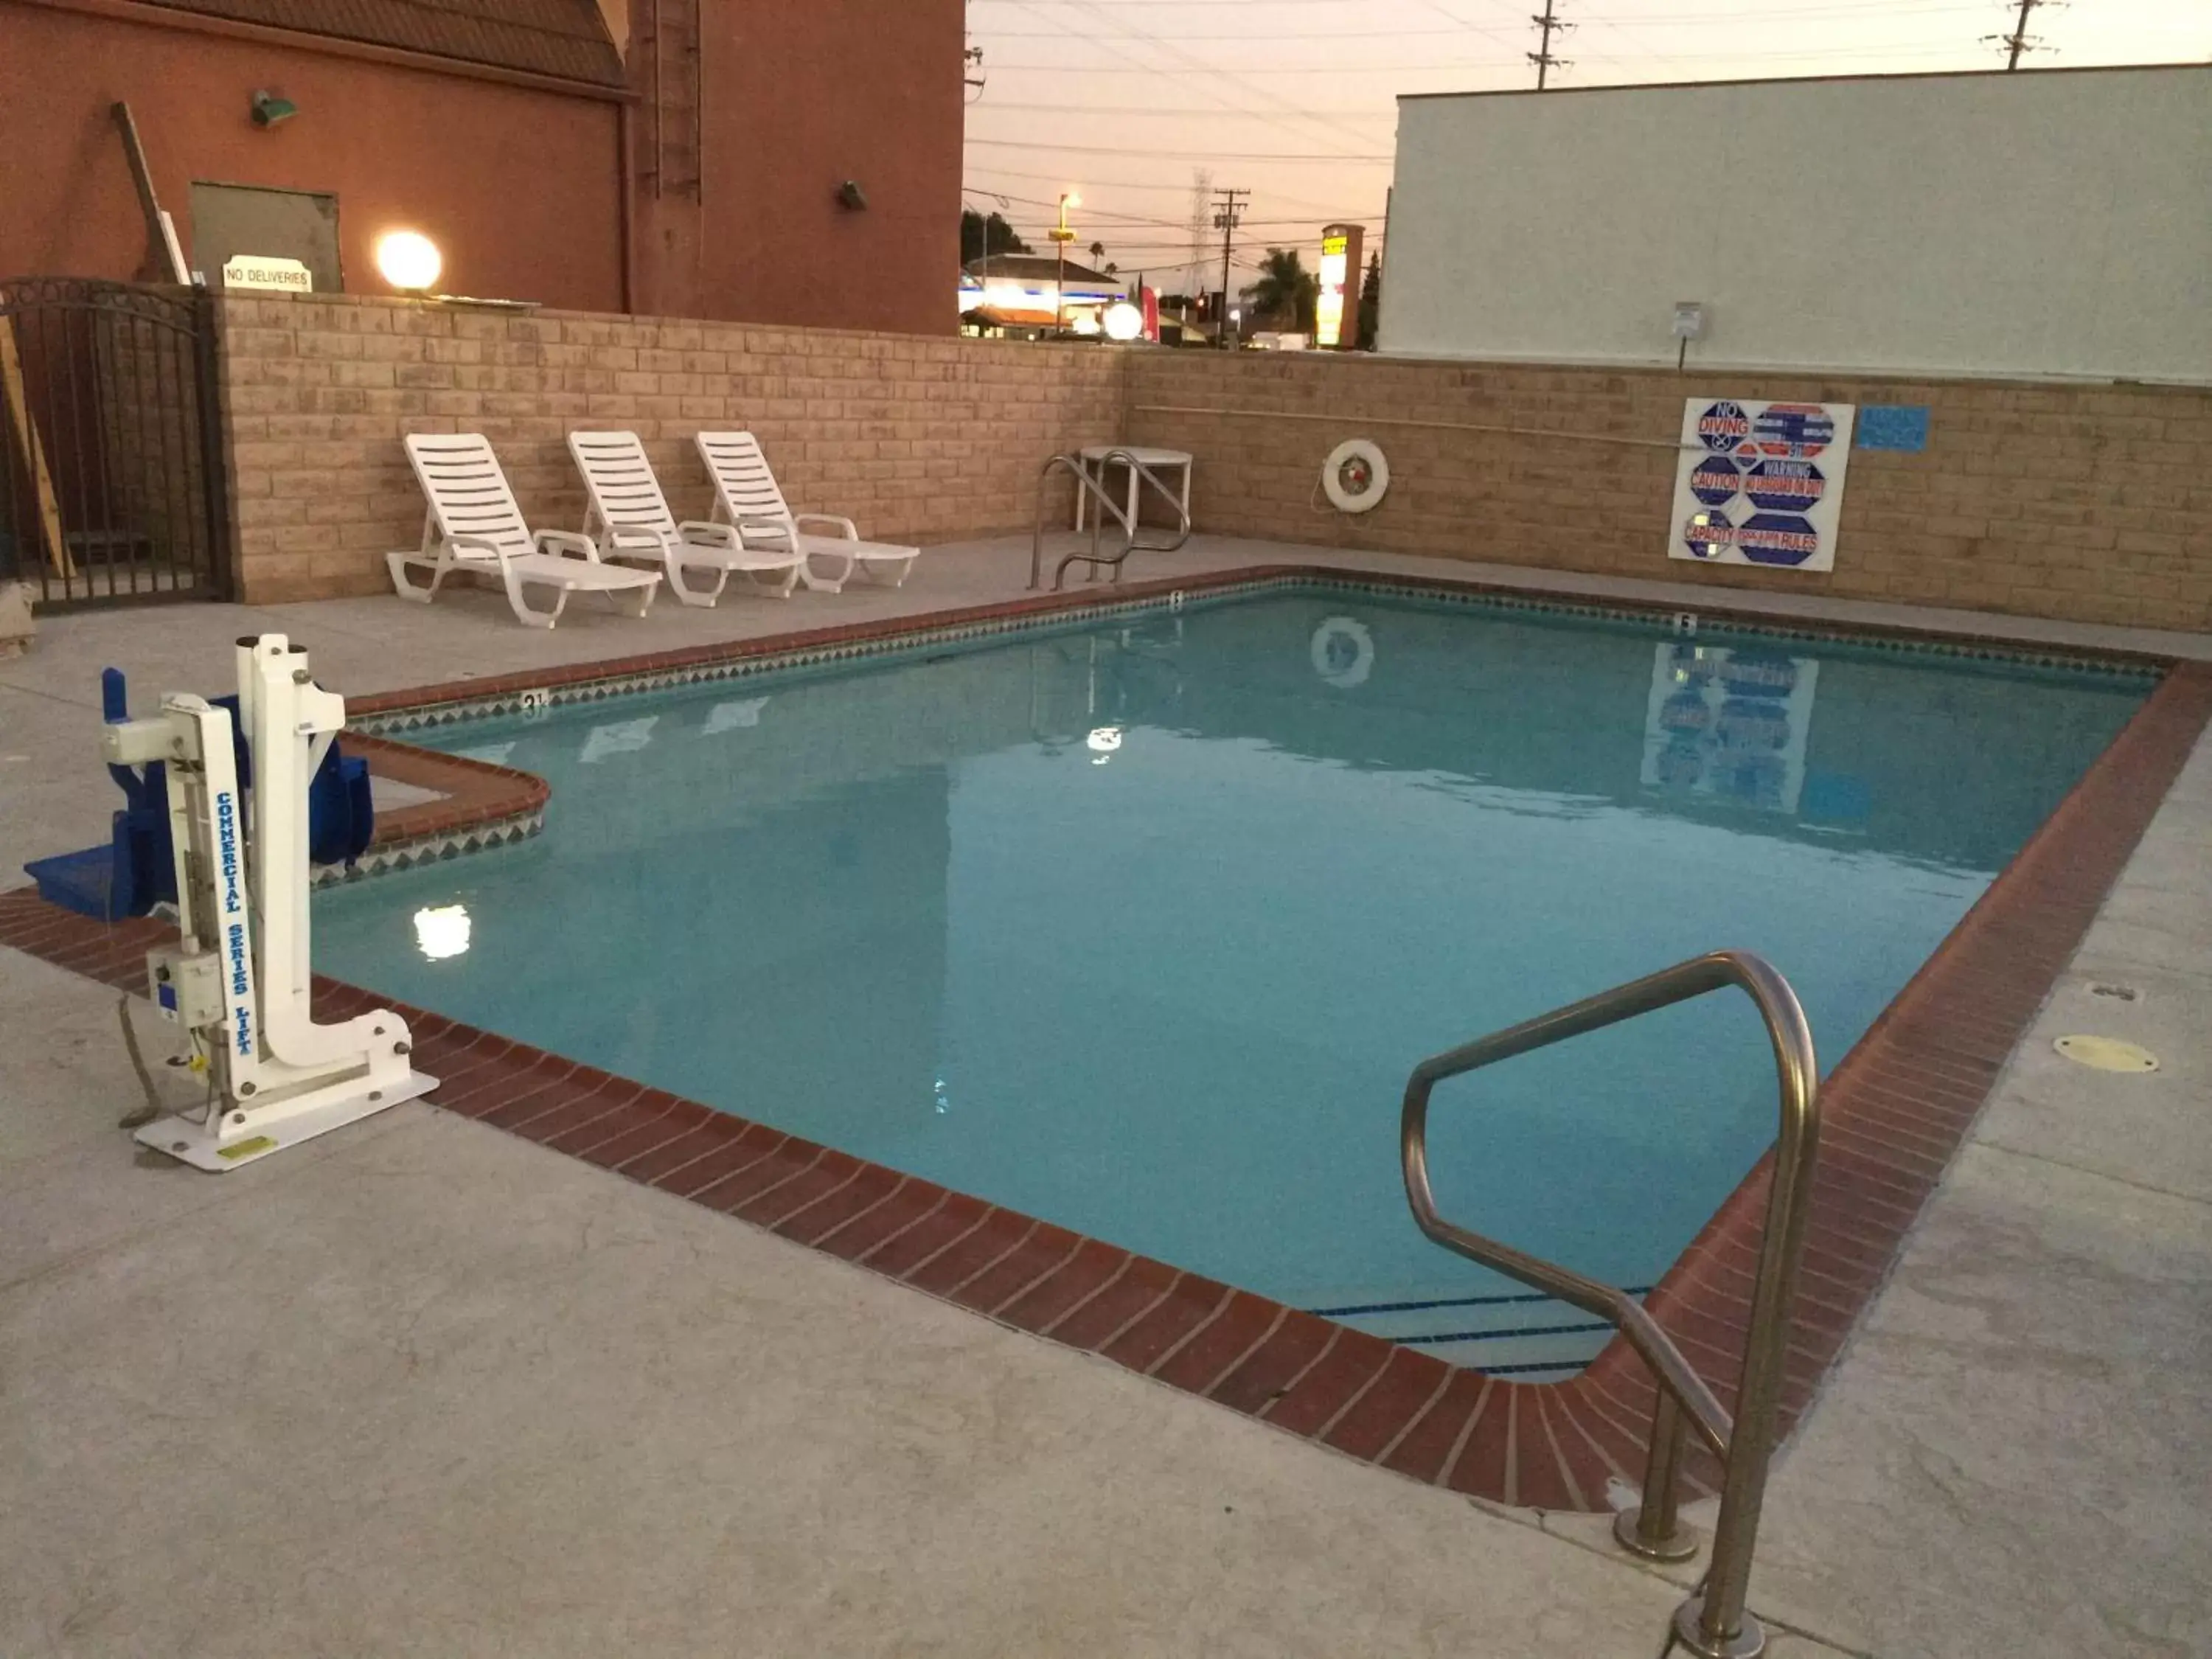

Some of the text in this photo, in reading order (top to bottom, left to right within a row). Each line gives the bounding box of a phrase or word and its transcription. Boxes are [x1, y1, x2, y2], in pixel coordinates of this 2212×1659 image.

[226, 268, 308, 285] NO DELIVERIES
[1716, 401, 1737, 418] NO
[1699, 415, 1748, 435] DIVING
[1764, 459, 1812, 479] WARNING
[1691, 470, 1739, 492] CAUTION
[1685, 523, 1733, 544] CAPACITY
[1781, 532, 1817, 552] RULES
[217, 792, 251, 1056] COMMERCIAL SERIES LIFT
